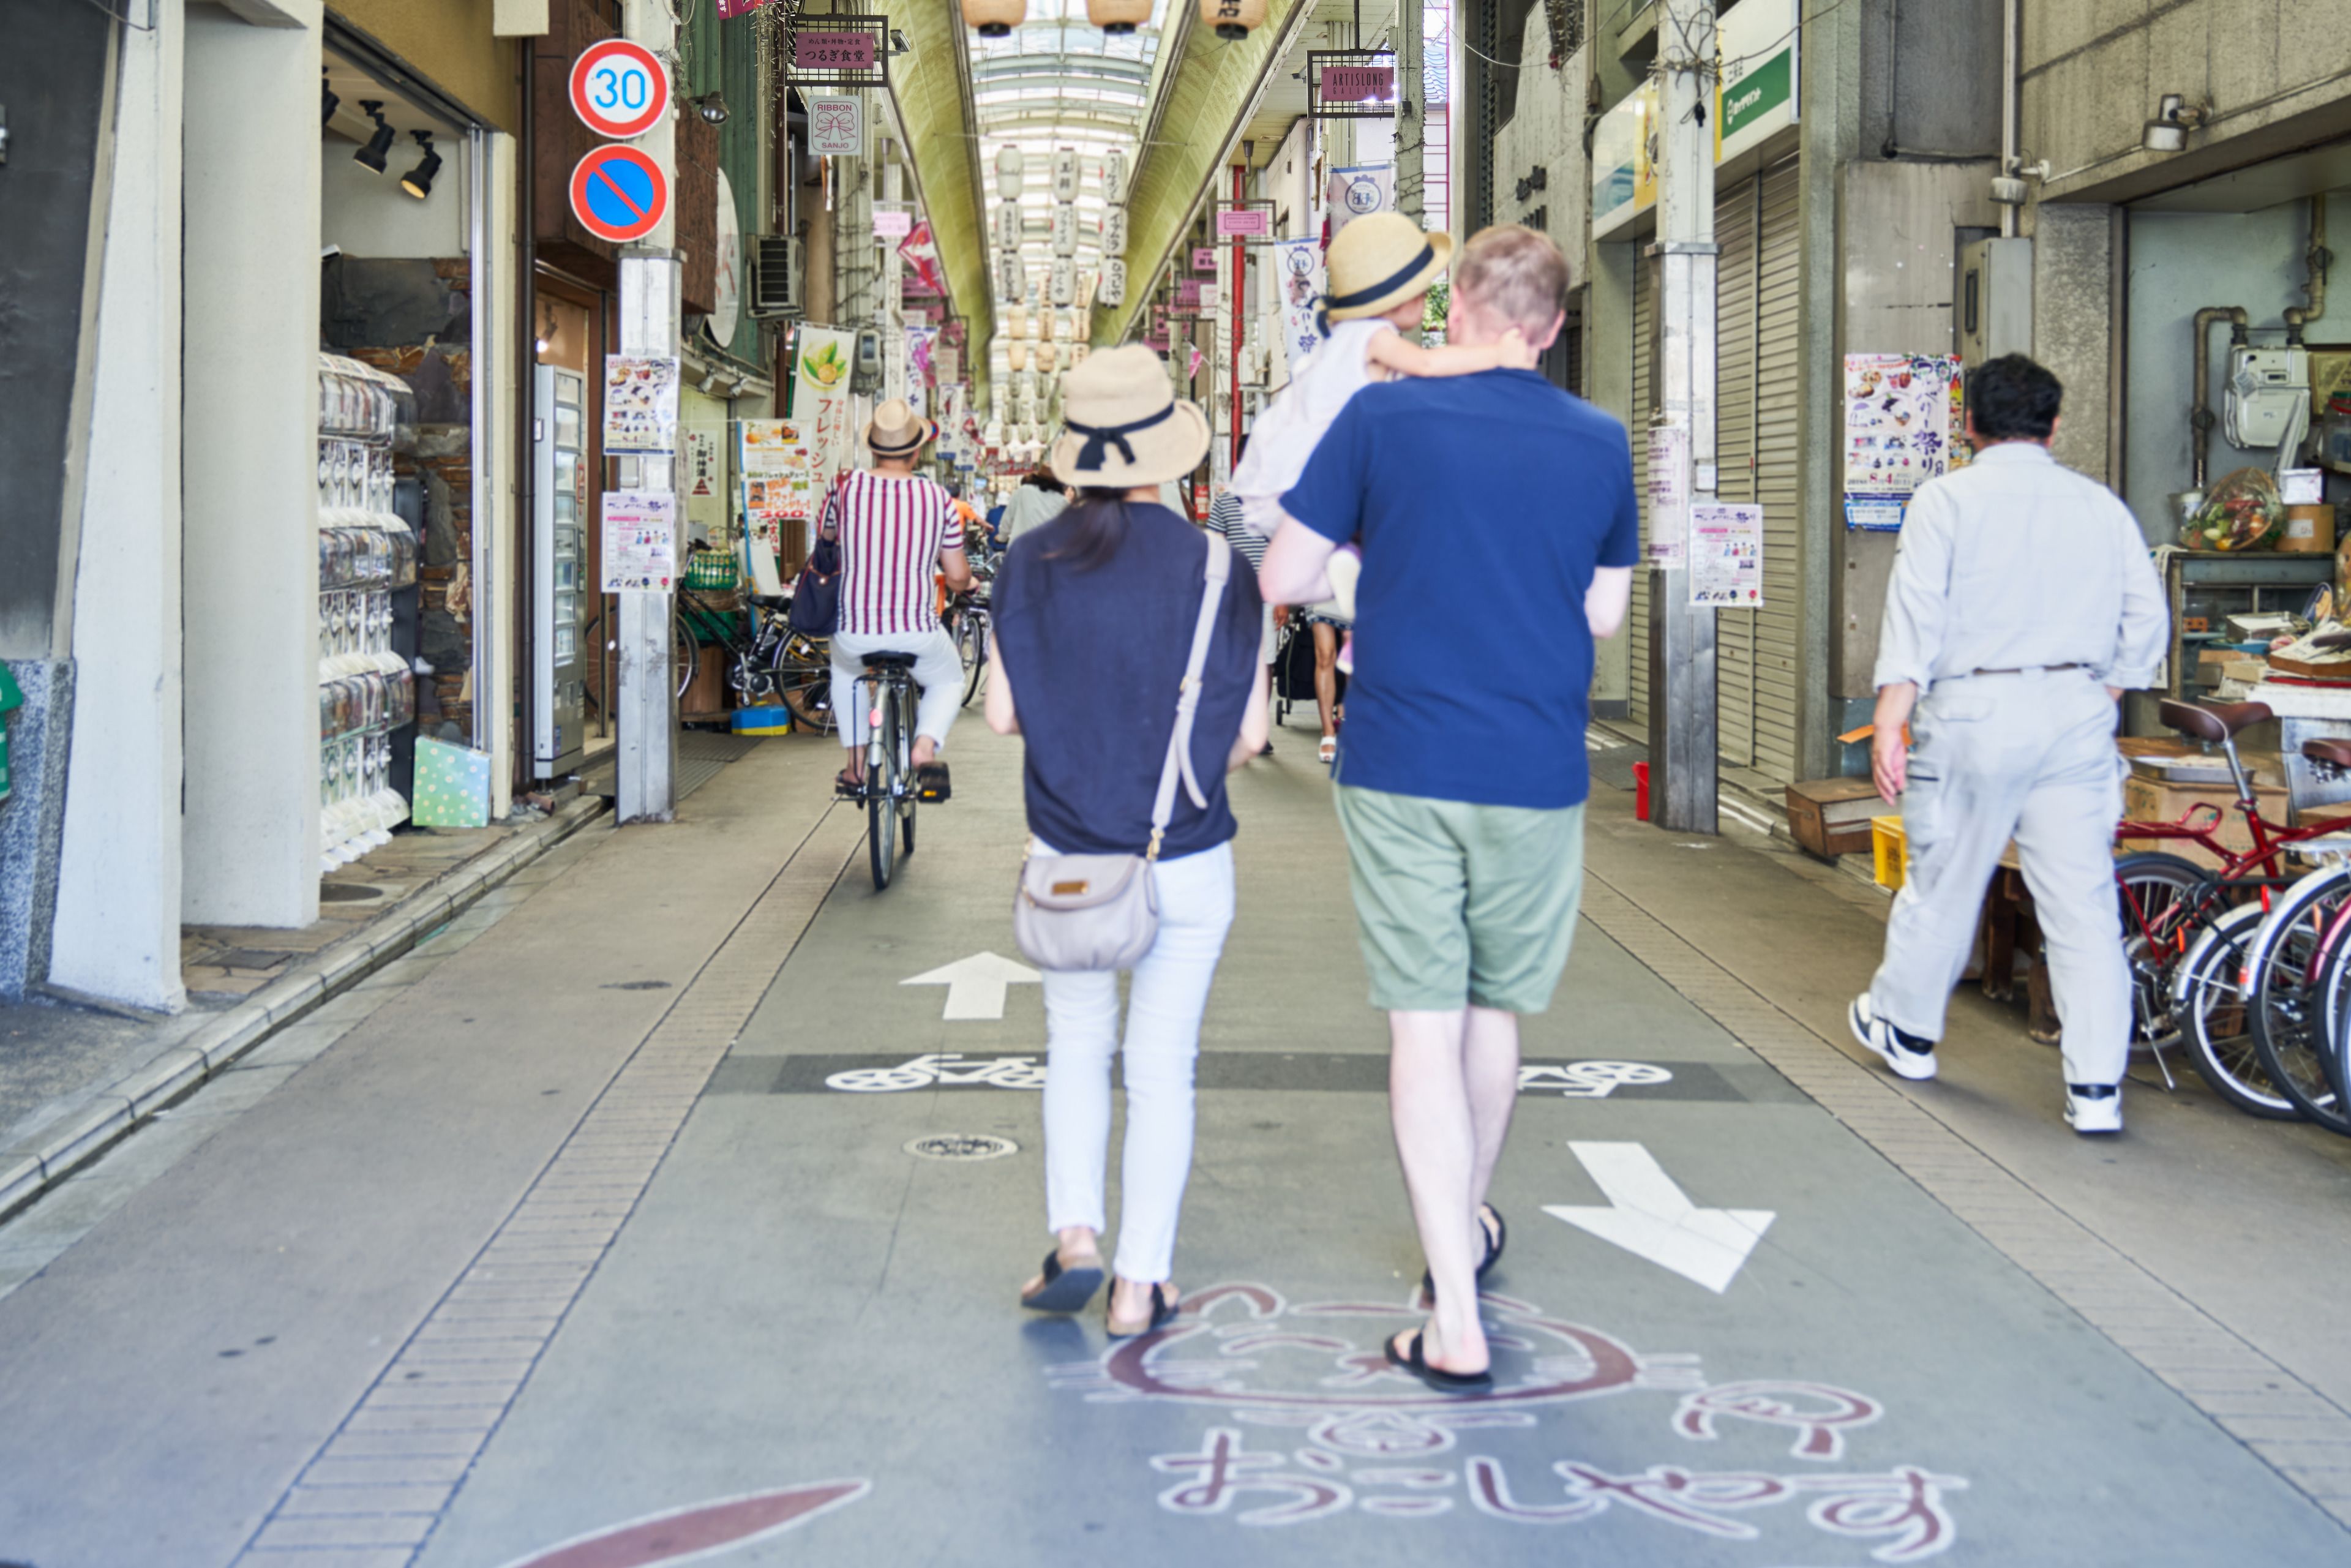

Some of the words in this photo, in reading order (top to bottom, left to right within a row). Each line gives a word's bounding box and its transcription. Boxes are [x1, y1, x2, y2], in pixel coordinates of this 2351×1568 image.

[804, 49, 865, 62] つるぎ食堂
[594, 68, 645, 109] 30
[1333, 73, 1384, 86] ARTISLONG
[811, 398, 832, 483] フレッシュ
[1150, 1428, 1969, 1561] おこしやす
